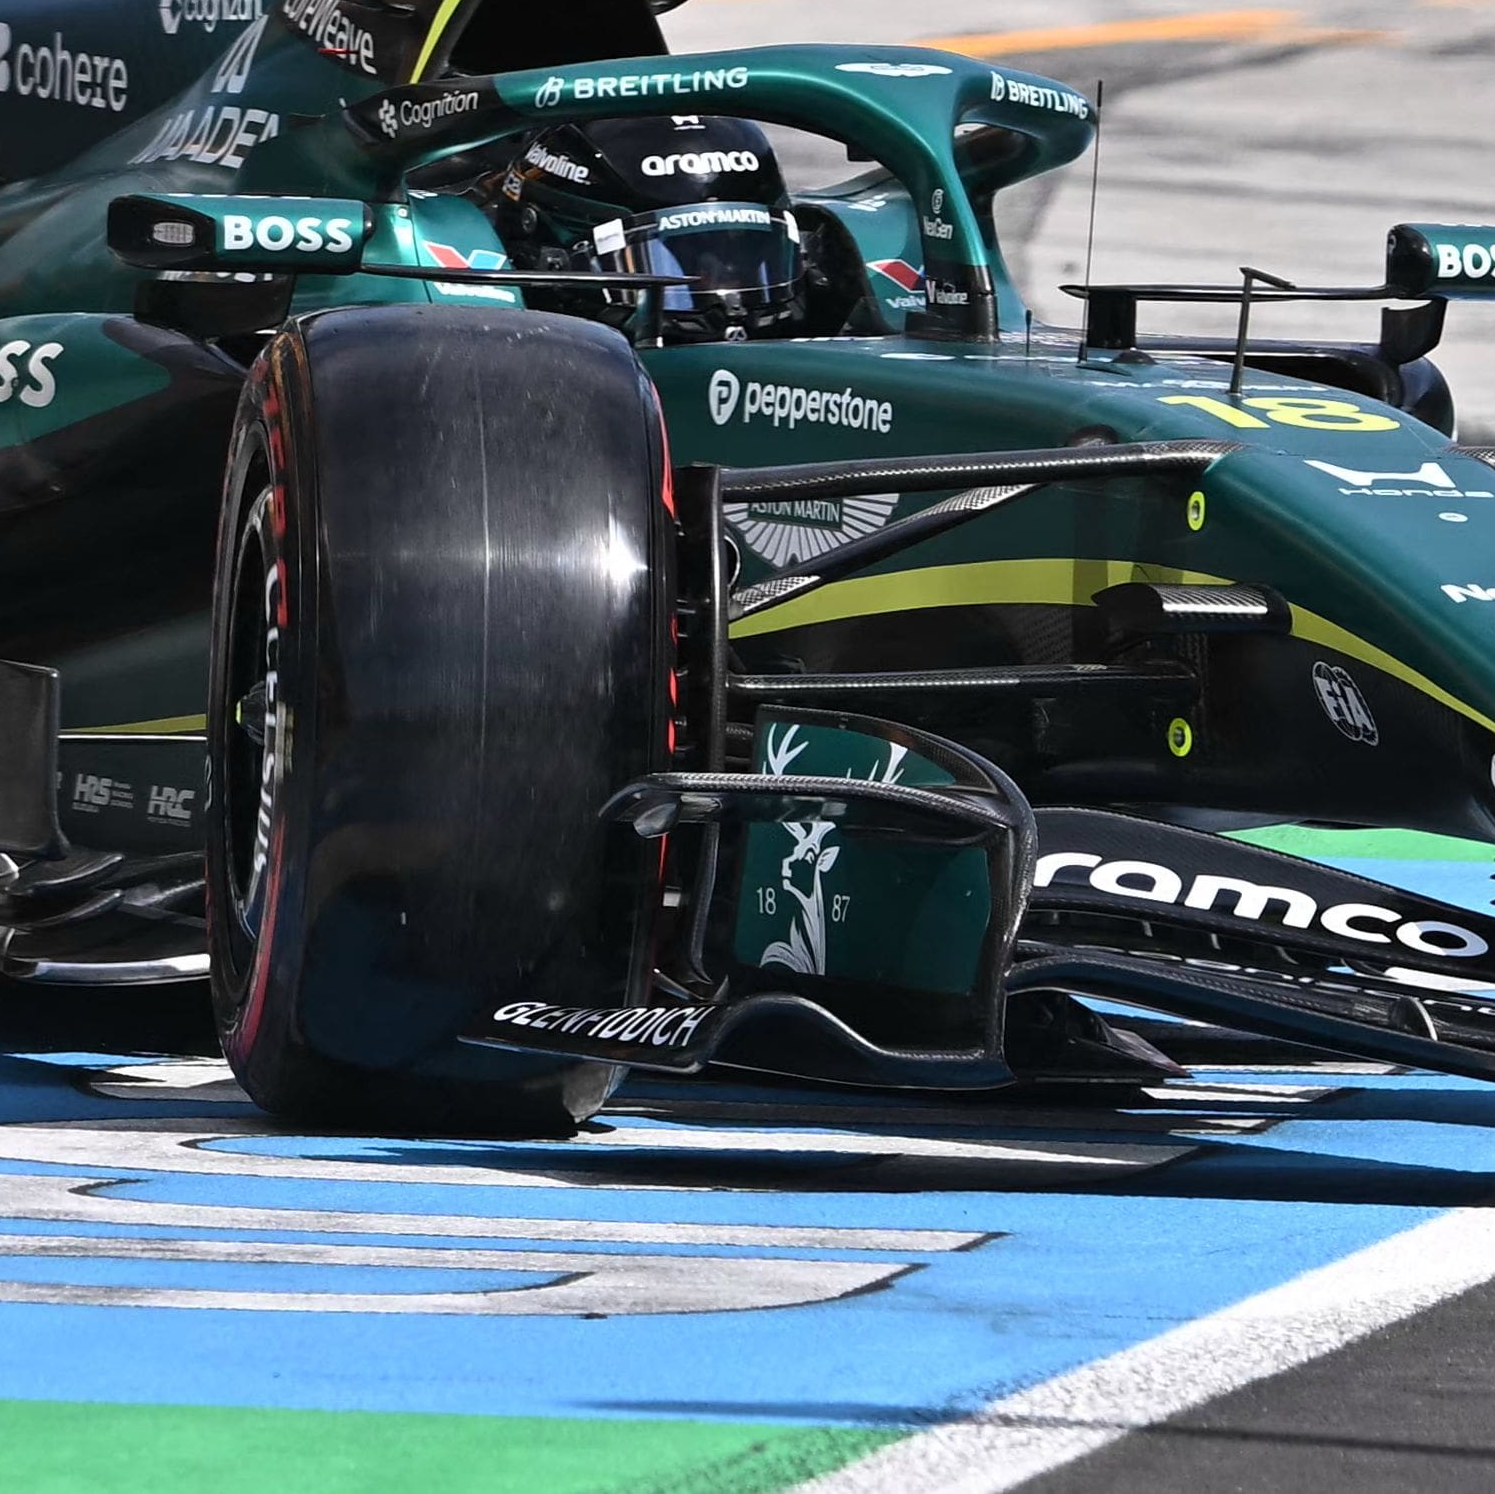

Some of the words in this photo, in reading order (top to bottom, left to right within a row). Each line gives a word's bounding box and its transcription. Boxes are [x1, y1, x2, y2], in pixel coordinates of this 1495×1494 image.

[16, 31, 128, 112] cohere
[573, 65, 749, 100] BREITLING
[399, 89, 479, 129] Cognition
[1007, 81, 1089, 120] BREITLING
[524, 140, 592, 186] Valvoline
[640, 149, 761, 177] aramco
[223, 214, 354, 254] BOSS
[658, 212, 711, 232] ASTON
[716, 208, 772, 226] MARTIN
[743, 382, 893, 433] pepperstone
[1156, 395, 1401, 432] 18
[1337, 487, 1495, 499] Honda
[794, 503, 841, 523] MARTIN
[756, 887, 777, 915] 18
[831, 894, 851, 923] 87
[1034, 851, 1489, 957] ramco
[492, 1001, 715, 1047] GLENFIDDICH
